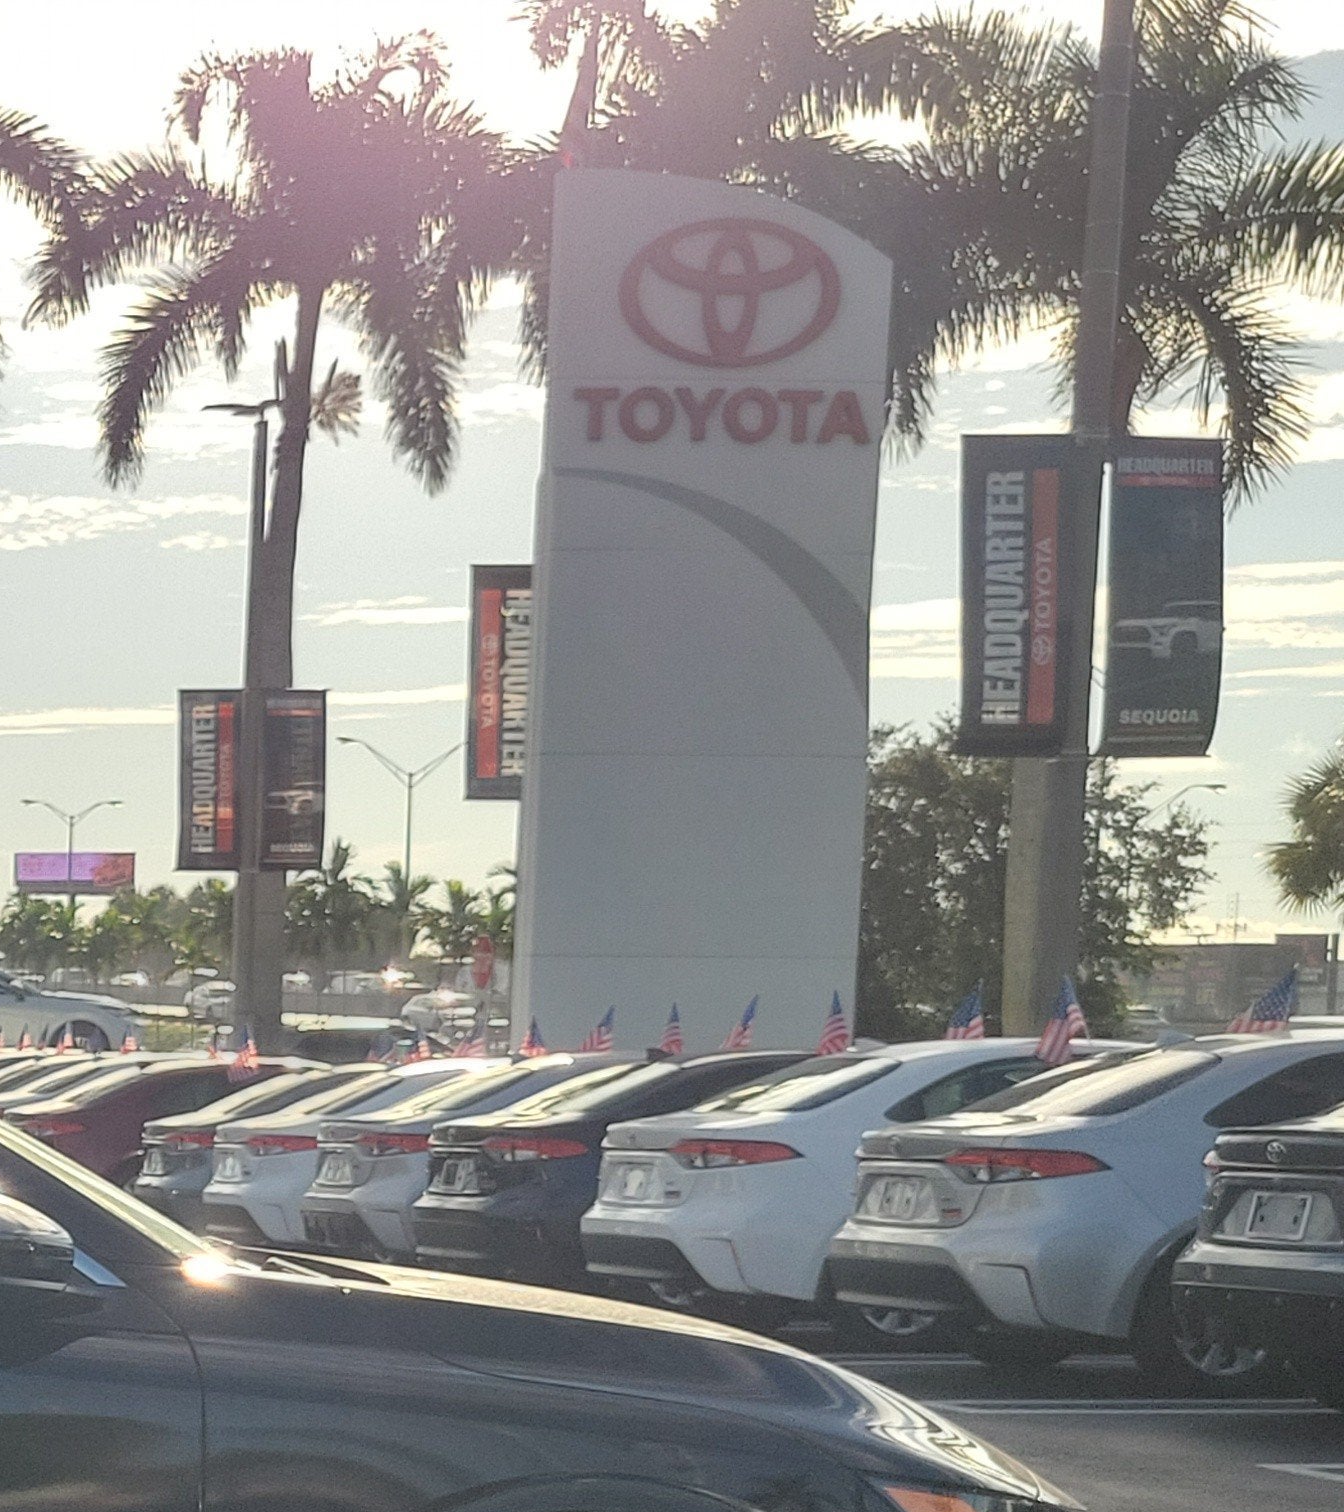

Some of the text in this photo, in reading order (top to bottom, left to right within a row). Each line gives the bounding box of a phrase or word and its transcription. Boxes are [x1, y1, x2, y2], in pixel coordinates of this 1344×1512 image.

[574, 386, 870, 445] TOYOTA
[981, 471, 1029, 725] HEADQUARTER
[1033, 538, 1054, 629] TOYOTA
[480, 659, 498, 729] TOYOTA
[499, 589, 534, 777] HEADQUARTER
[1118, 708, 1199, 726] SEQUOIA
[191, 704, 217, 854] HEADQUARTER
